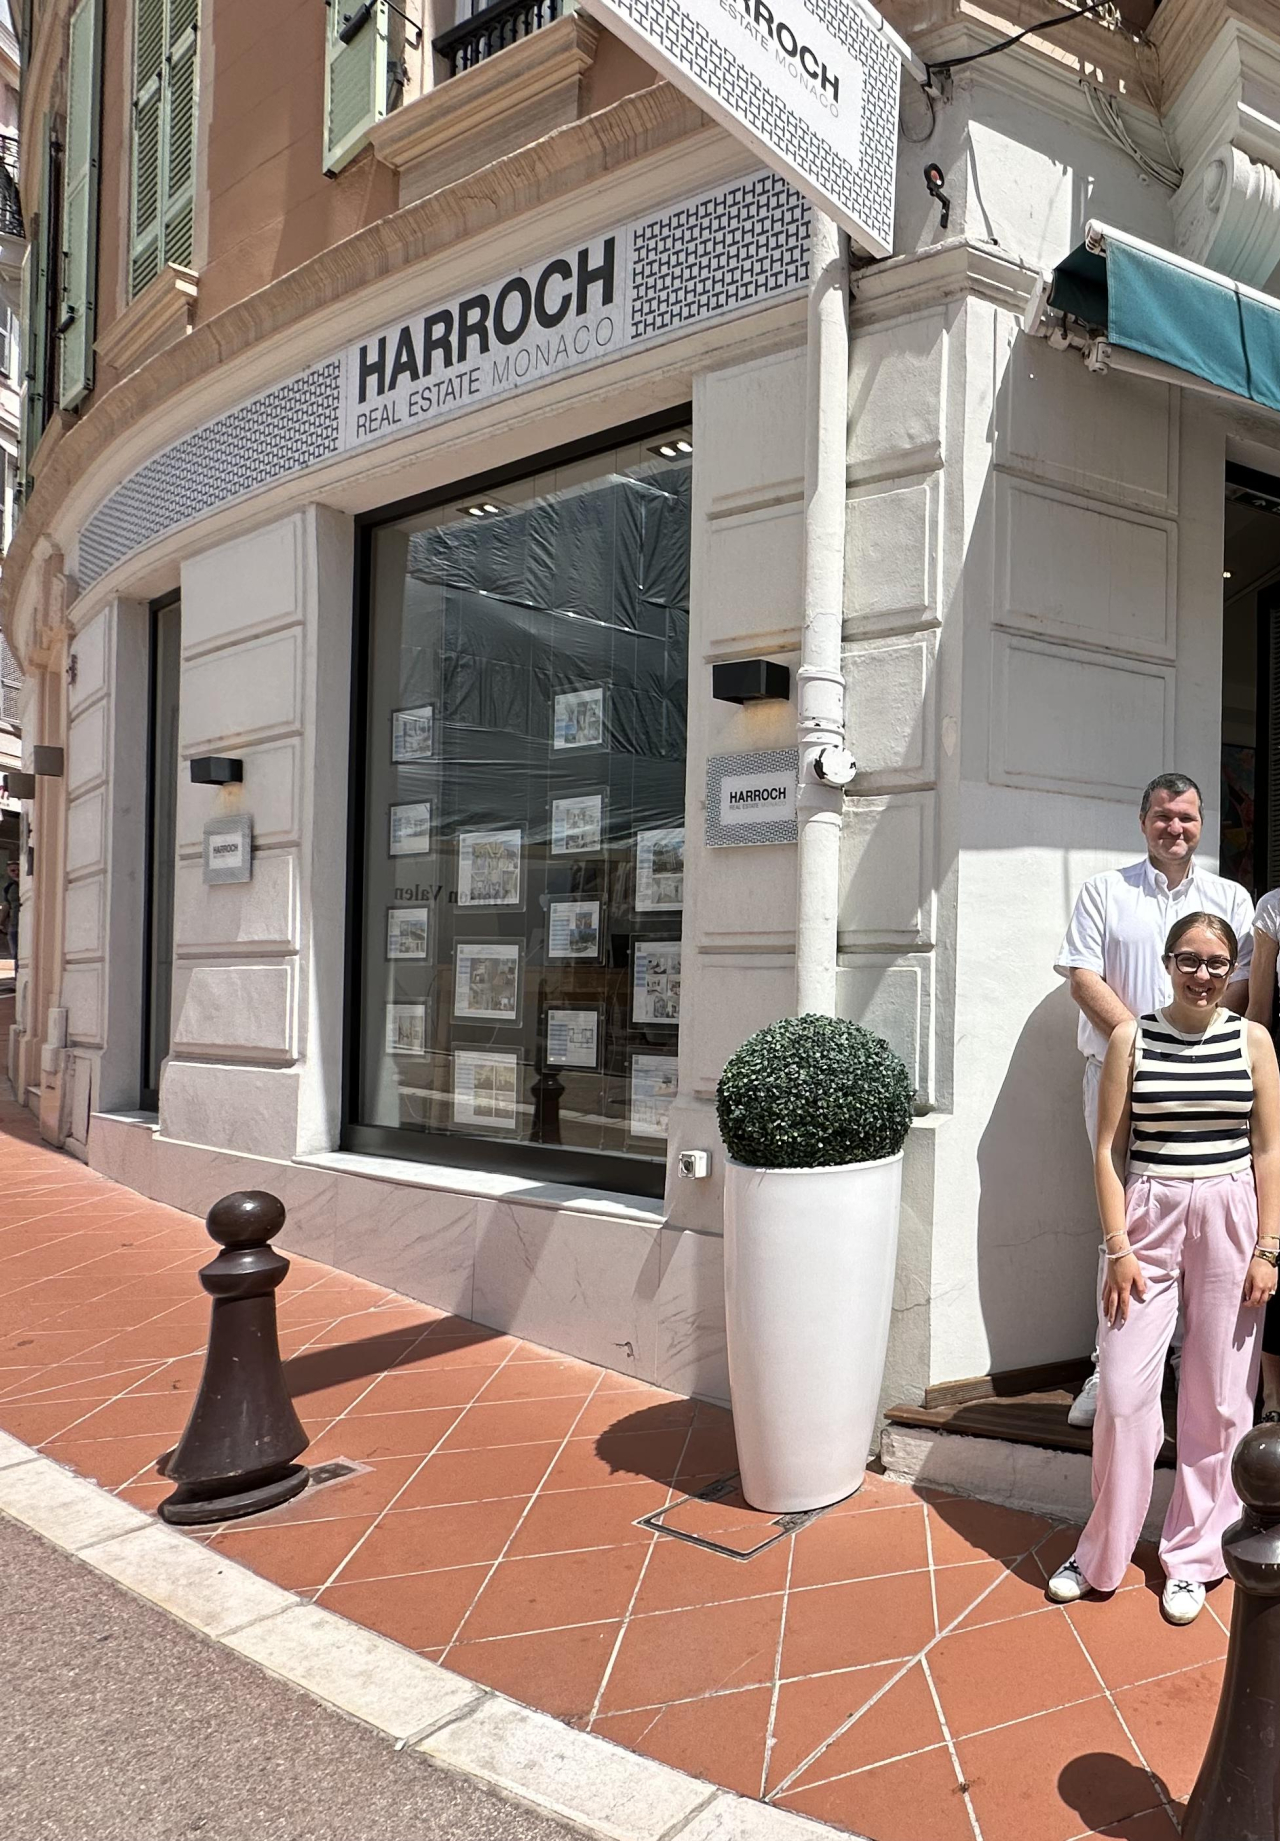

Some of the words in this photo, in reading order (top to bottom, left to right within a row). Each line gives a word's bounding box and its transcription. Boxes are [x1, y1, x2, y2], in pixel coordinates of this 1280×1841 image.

[719, 0, 769, 52] ESTATE
[775, 48, 839, 118] MONACO
[356, 401, 402, 439] REAL
[408, 367, 480, 418] ESTATE
[491, 315, 614, 388] MONACO
[358, 236, 616, 404] HARROCH
[213, 843, 239, 854] HARROCH
[729, 787, 787, 804] HARROCH
